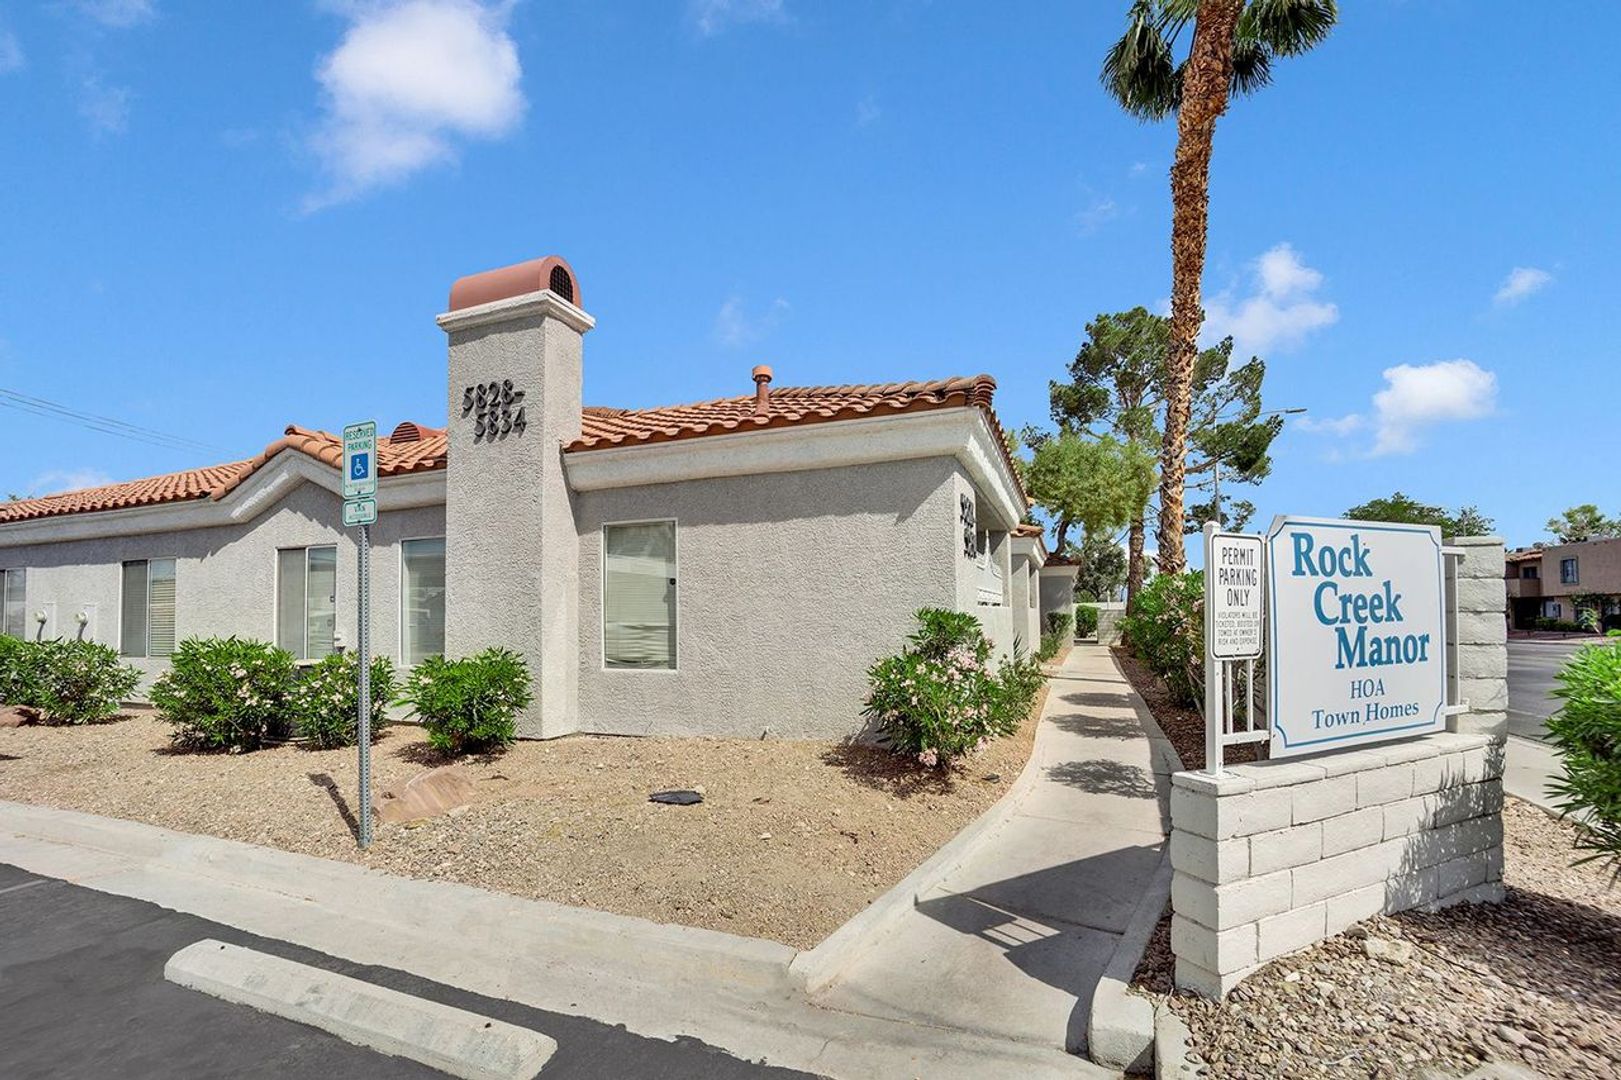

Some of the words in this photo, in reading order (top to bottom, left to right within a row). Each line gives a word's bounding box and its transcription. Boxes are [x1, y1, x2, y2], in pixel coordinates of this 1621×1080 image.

[463, 379, 526, 412] 5828-
[345, 427, 374, 440] RESERVED
[474, 407, 527, 438] 5834
[348, 439, 372, 451] PARKING
[1221, 547, 1254, 566] PERMIT
[1290, 532, 1373, 577] Rock
[1219, 568, 1258, 587] PARKING
[1226, 588, 1250, 607] ONLY
[1313, 580, 1403, 626] Creek
[1335, 626, 1430, 669] Manor
[1350, 678, 1385, 699] HOA
[1311, 709, 1360, 729] Town
[1365, 702, 1419, 722] Homes
